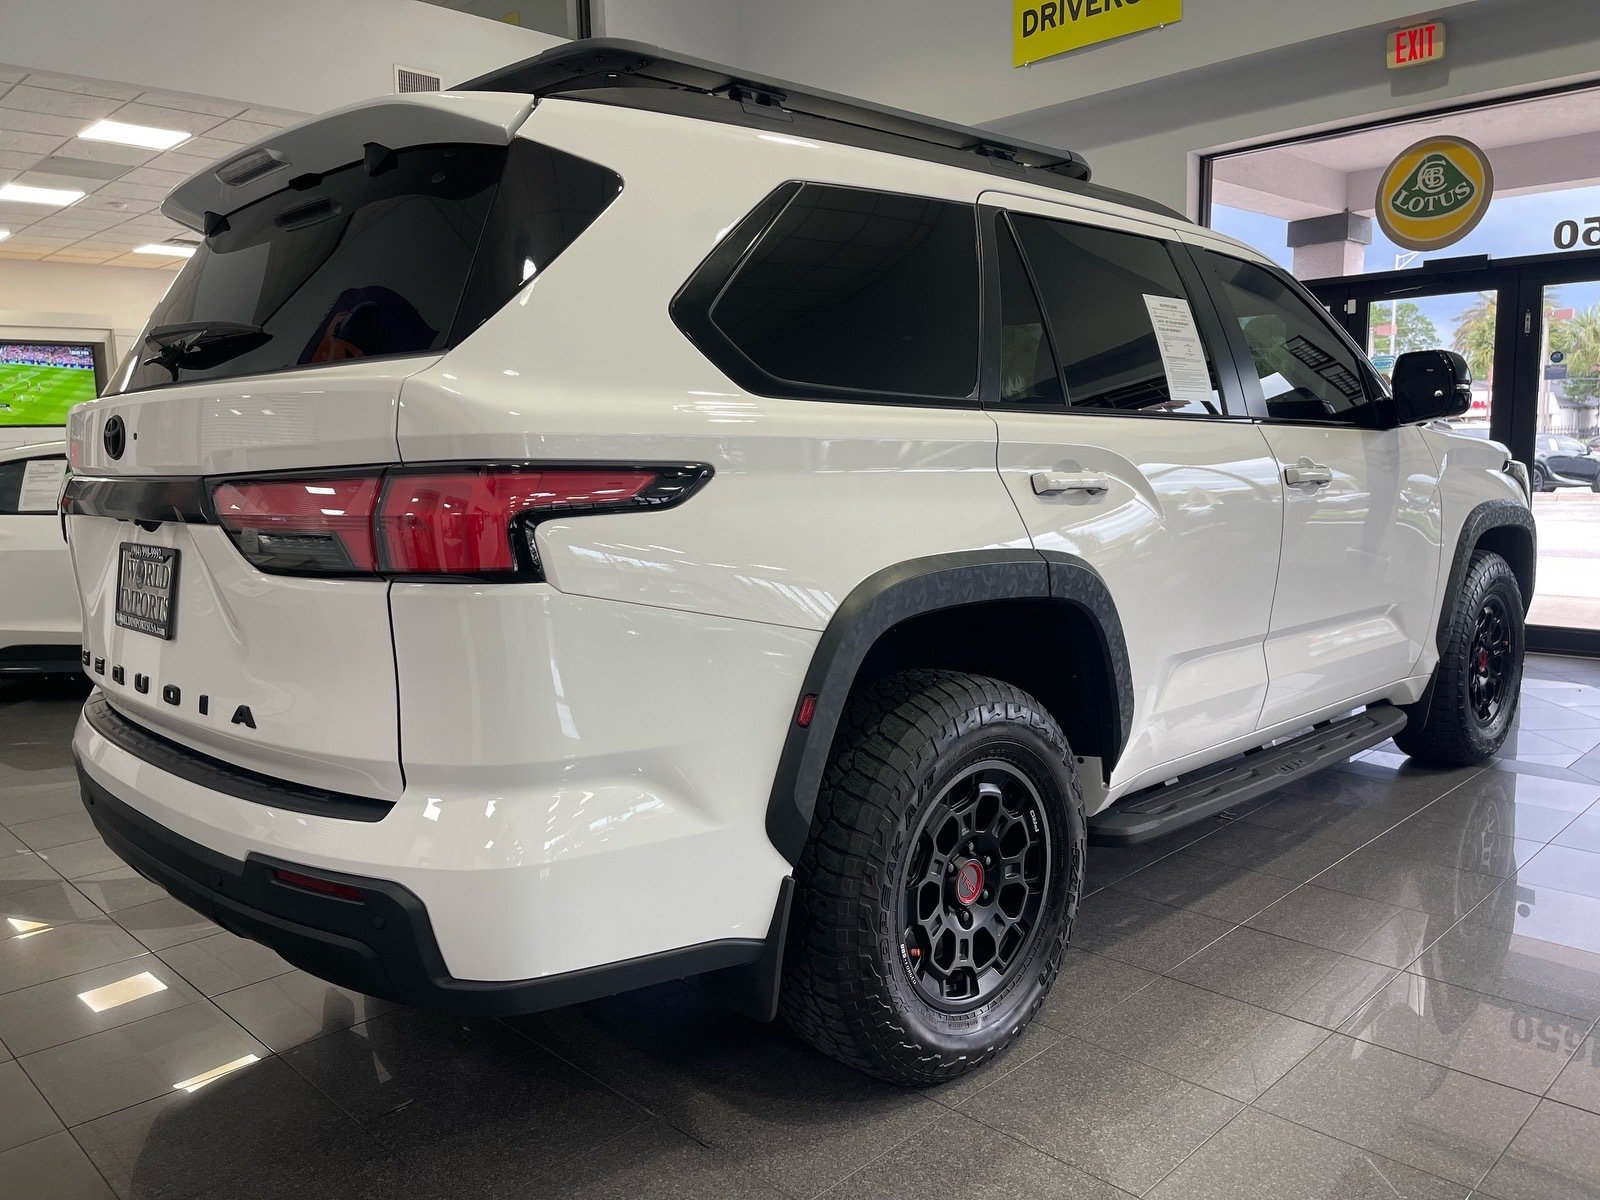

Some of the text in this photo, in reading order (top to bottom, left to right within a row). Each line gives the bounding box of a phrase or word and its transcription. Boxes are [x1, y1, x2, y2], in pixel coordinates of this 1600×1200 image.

[1022, 0, 1140, 38] DRIVE
[1395, 25, 1436, 64] EXIT
[1393, 182, 1471, 213] LOTUS
[126, 559, 171, 590] WORLD
[121, 588, 169, 622] IMPORTS
[82, 649, 257, 729] SEQUOIA
